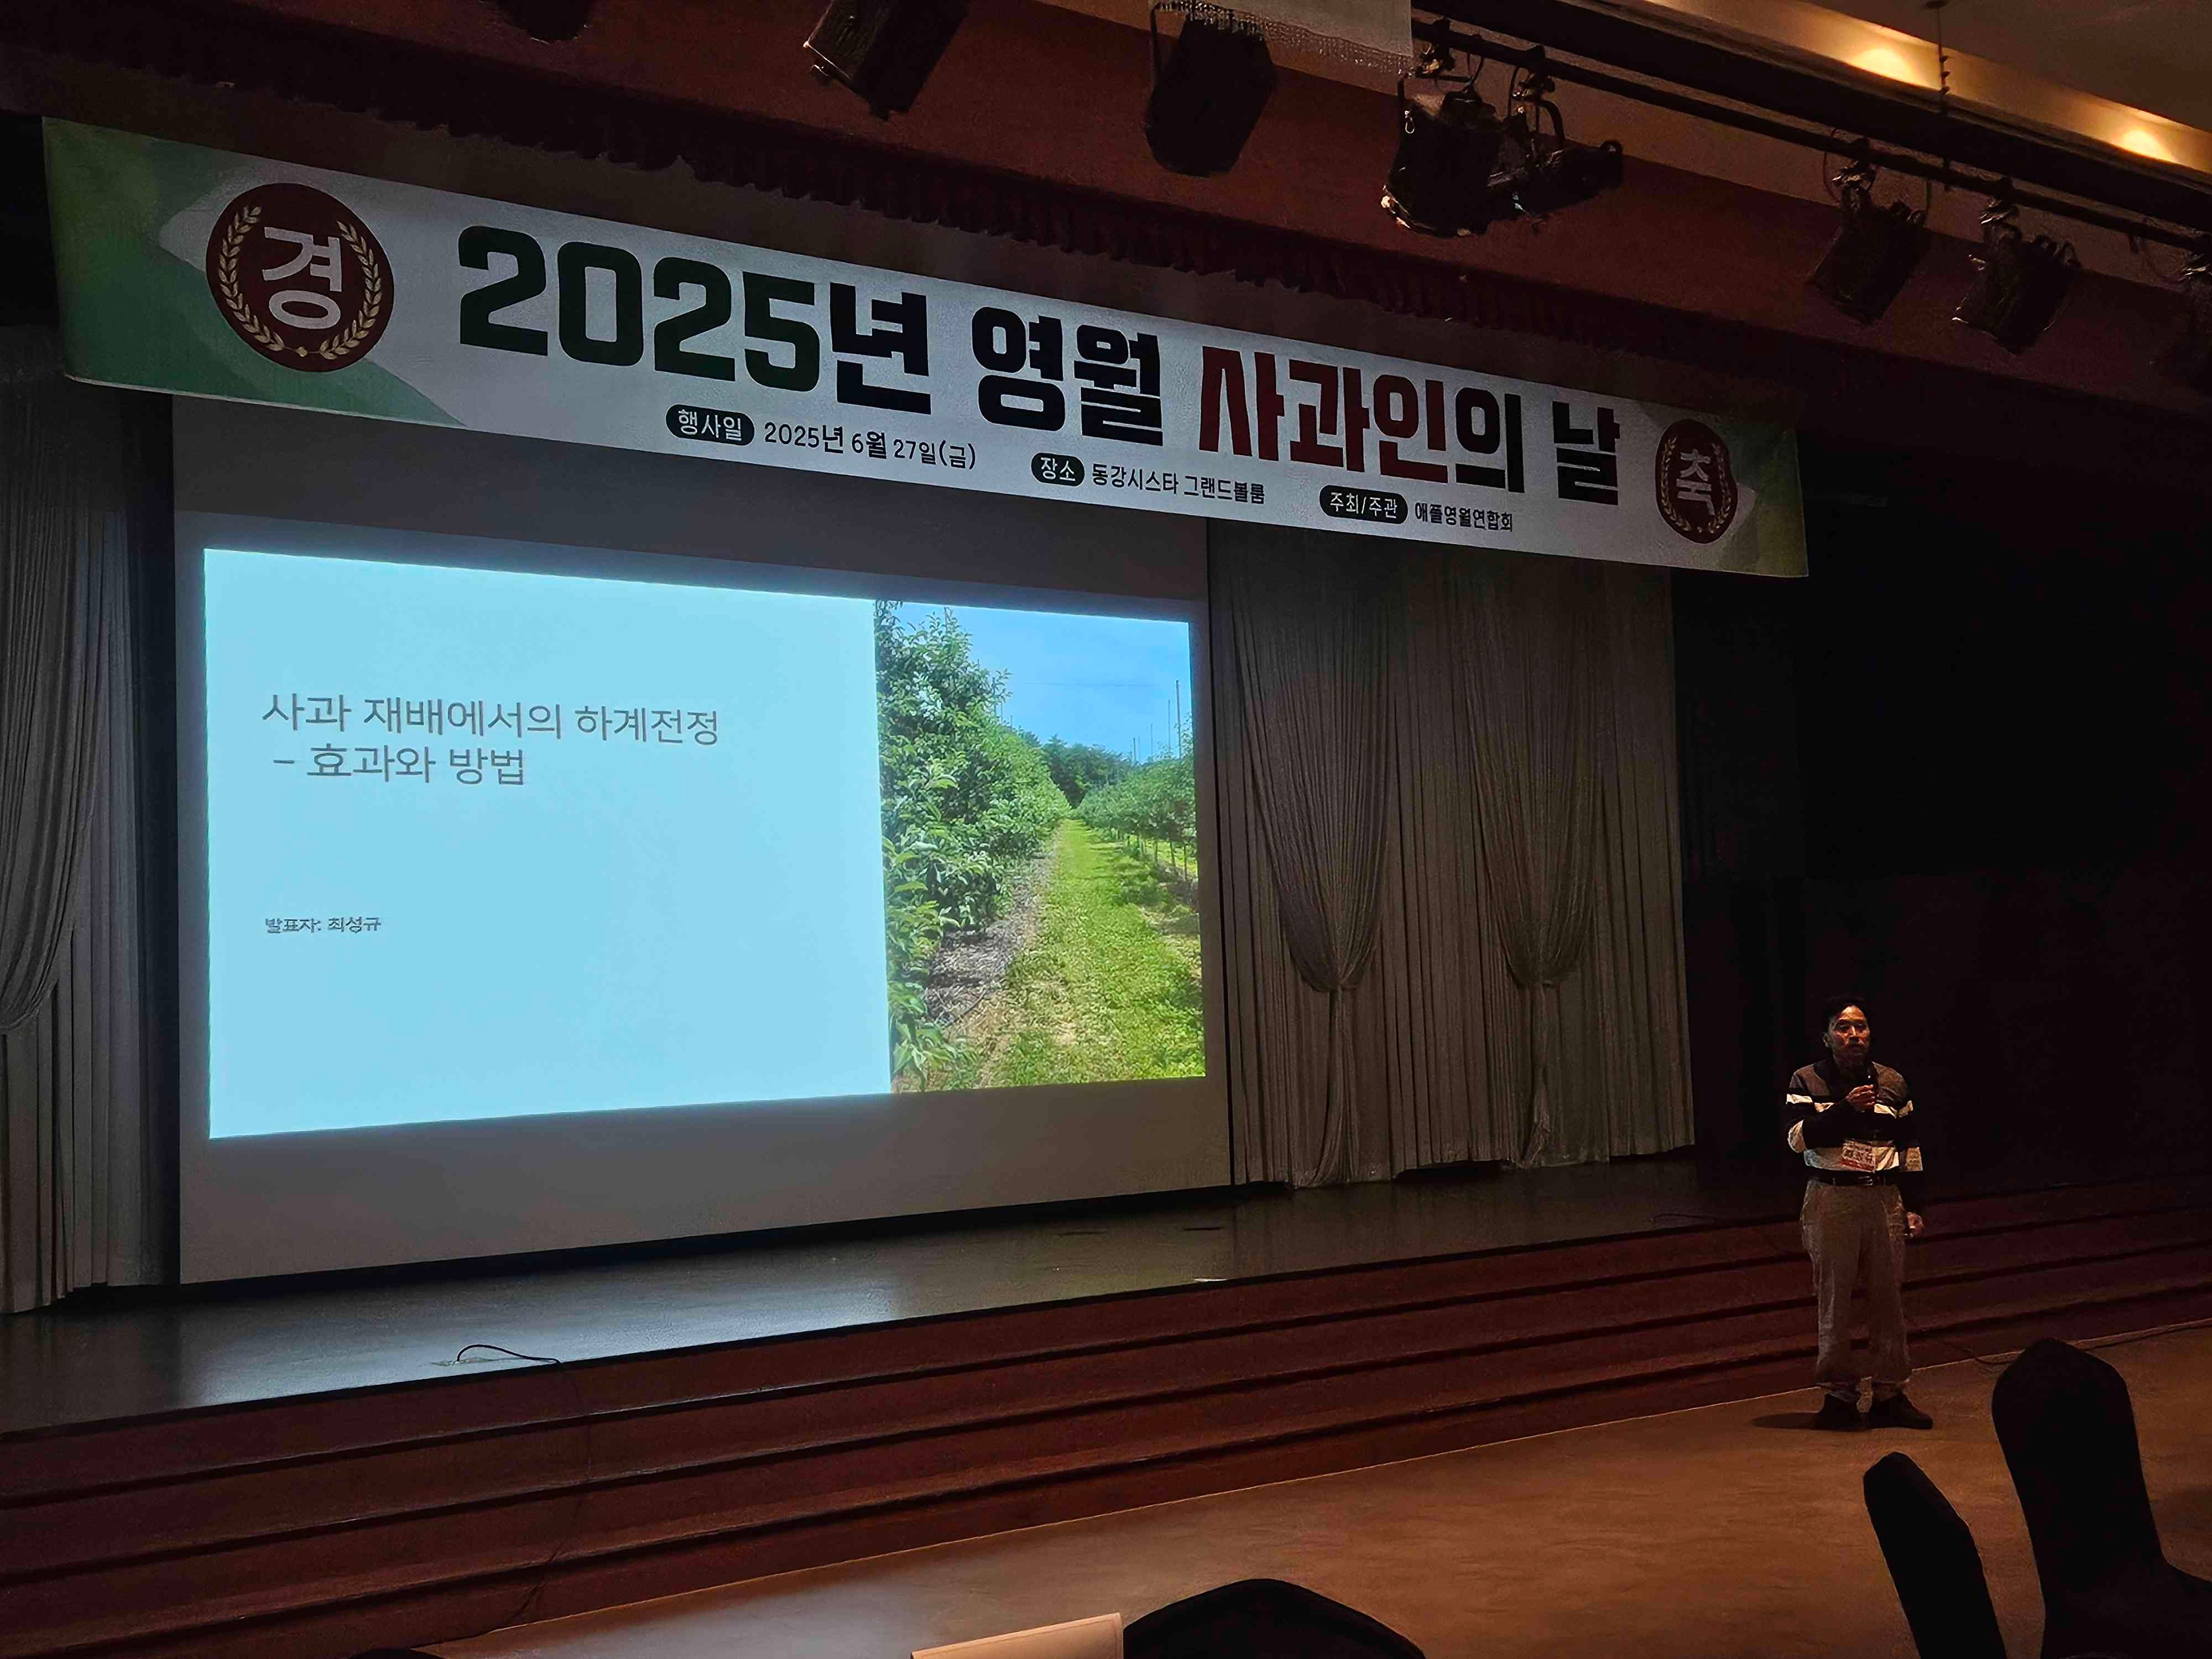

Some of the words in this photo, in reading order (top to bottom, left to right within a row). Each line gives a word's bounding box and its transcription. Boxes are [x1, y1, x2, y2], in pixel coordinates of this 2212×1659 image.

[262, 224, 344, 331] 경
[458, 224, 932, 415] 2025년
[971, 305, 1164, 447] 영월
[1198, 343, 1524, 494] 사과인의
[1553, 400, 1621, 507] 날
[677, 409, 742, 442] 행사일
[764, 422, 844, 455] 2025년
[852, 431, 887, 460] 6월
[893, 439, 977, 470] 27일(금)
[1040, 456, 1076, 482] 장소
[1092, 463, 1179, 494] 동강시스타
[1183, 475, 1265, 505] 그랜드볼룸
[1676, 446, 1718, 517] 축
[1329, 492, 1398, 519] 주최/주관
[1414, 502, 1513, 533] 애플영월연합회
[262, 692, 352, 732] 사과
[363, 696, 562, 740] 재배에서의
[575, 705, 719, 746] 하계전정
[306, 743, 436, 784] 효과와
[448, 746, 526, 786] 방법
[265, 917, 322, 934] 발표자:
[327, 916, 382, 934] 최성규
